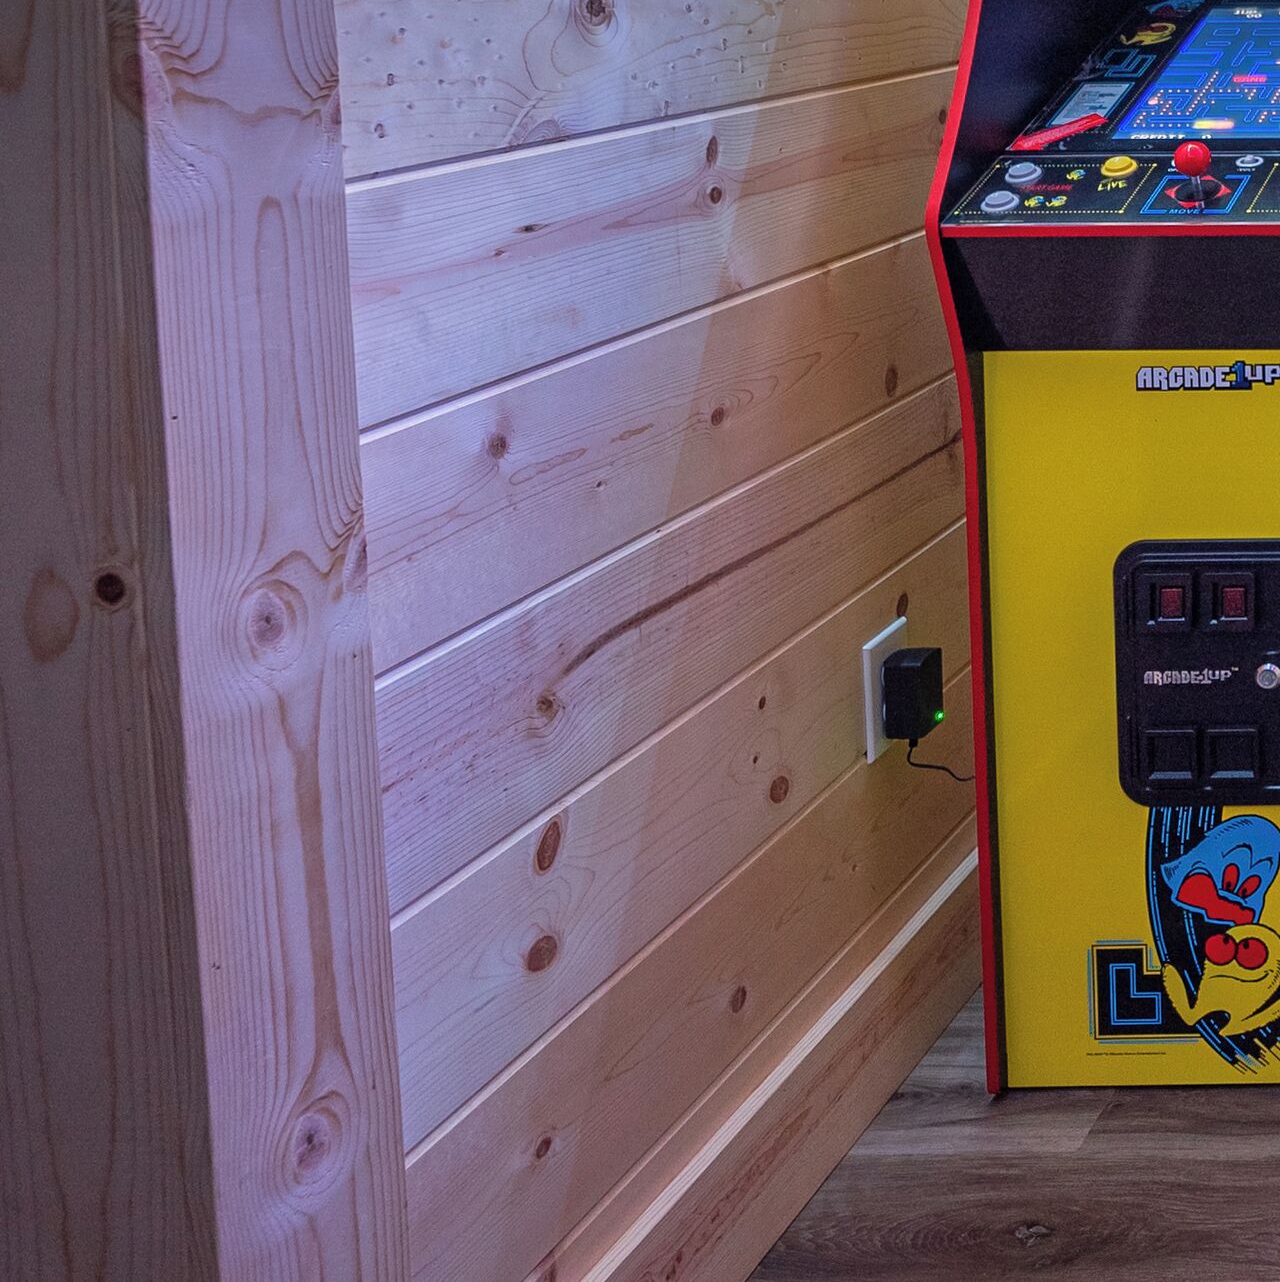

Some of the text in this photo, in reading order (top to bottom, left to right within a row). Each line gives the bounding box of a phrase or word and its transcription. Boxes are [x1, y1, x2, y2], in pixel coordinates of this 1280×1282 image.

[1232, 75, 1268, 83] GAME
[1097, 180, 1128, 192] LIVE
[1143, 667, 1232, 686] ARCADE1UP
